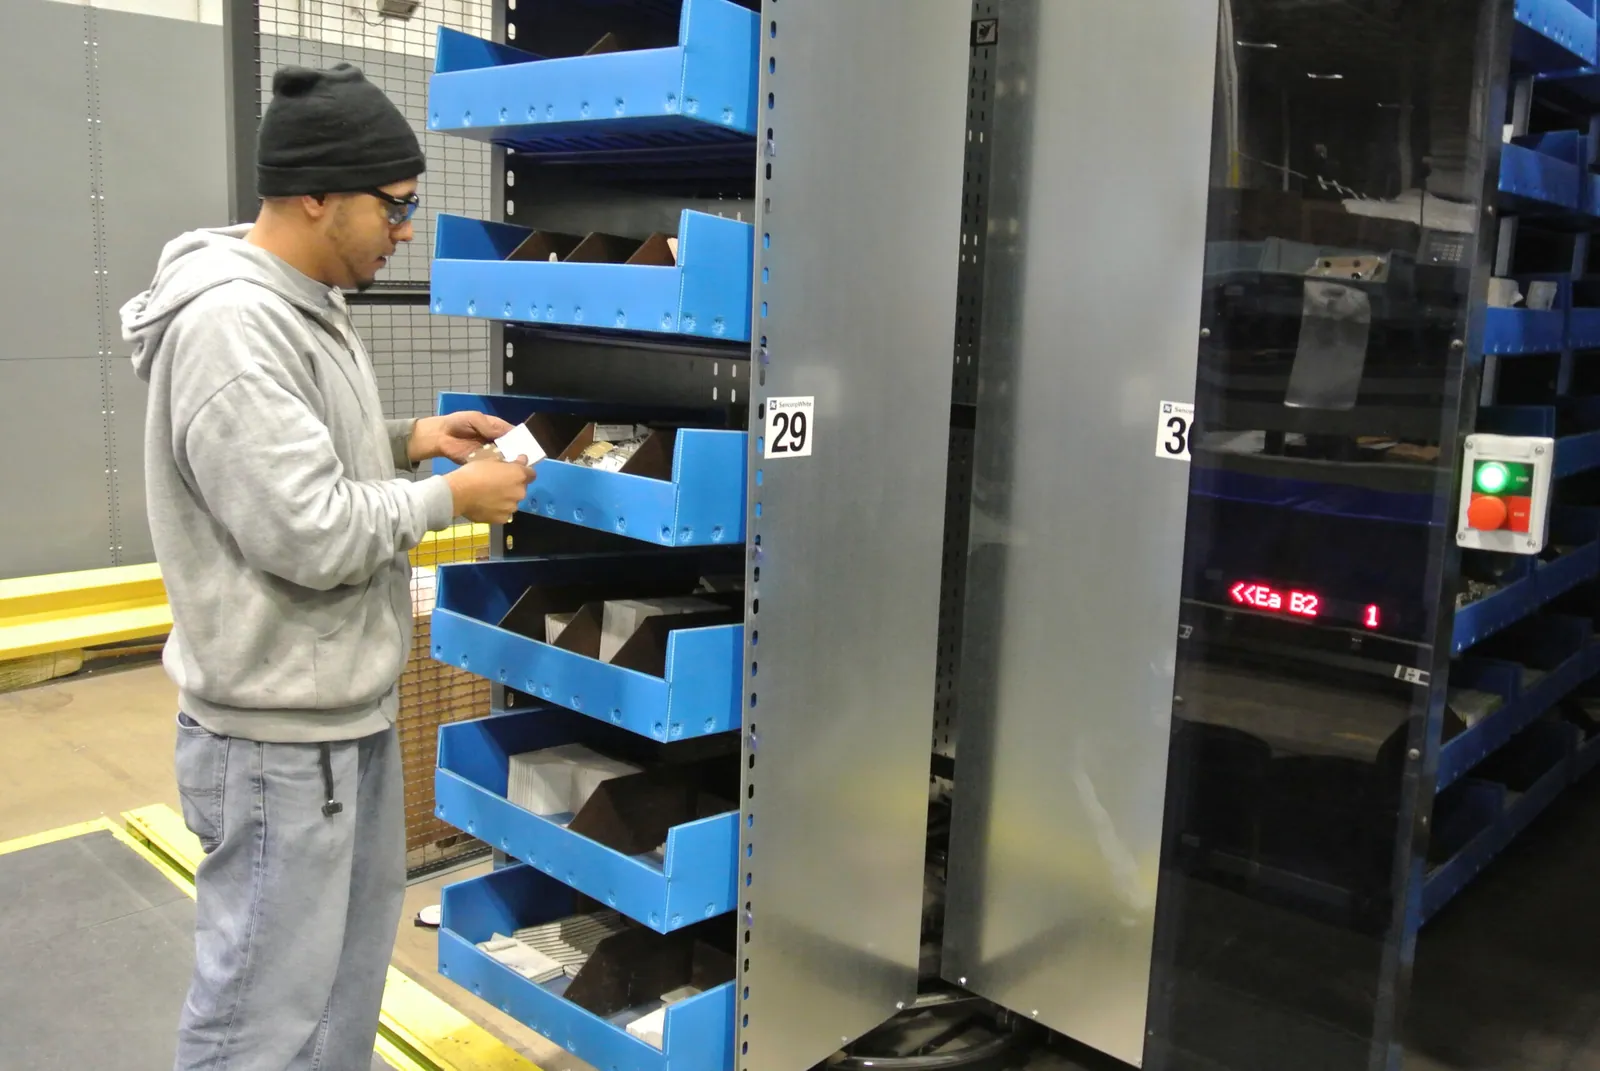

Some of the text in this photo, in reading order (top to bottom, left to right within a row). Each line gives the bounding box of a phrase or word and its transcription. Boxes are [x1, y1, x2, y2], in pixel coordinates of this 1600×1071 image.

[771, 411, 807, 453] 29
[1164, 416, 1193, 455] 3
[1289, 591, 1319, 616] B2
[1366, 604, 1379, 627] 1
